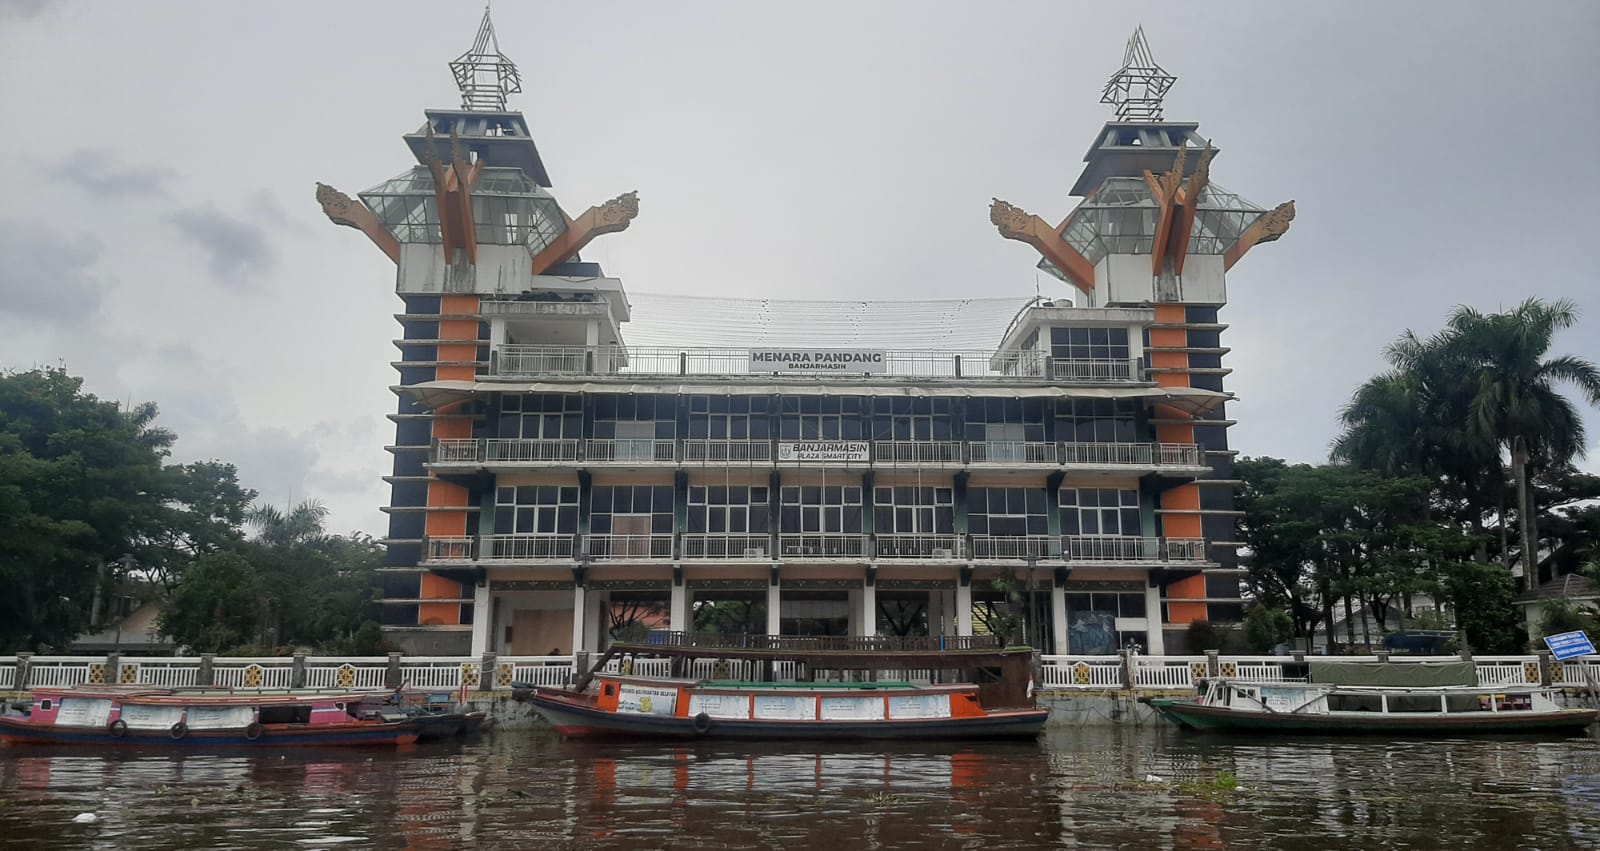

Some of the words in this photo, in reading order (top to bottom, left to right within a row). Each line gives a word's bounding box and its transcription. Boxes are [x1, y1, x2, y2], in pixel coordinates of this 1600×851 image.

[752, 352, 810, 362] MENARA
[814, 352, 882, 363] PANDANG
[792, 443, 868, 453] BANJARMASIN
